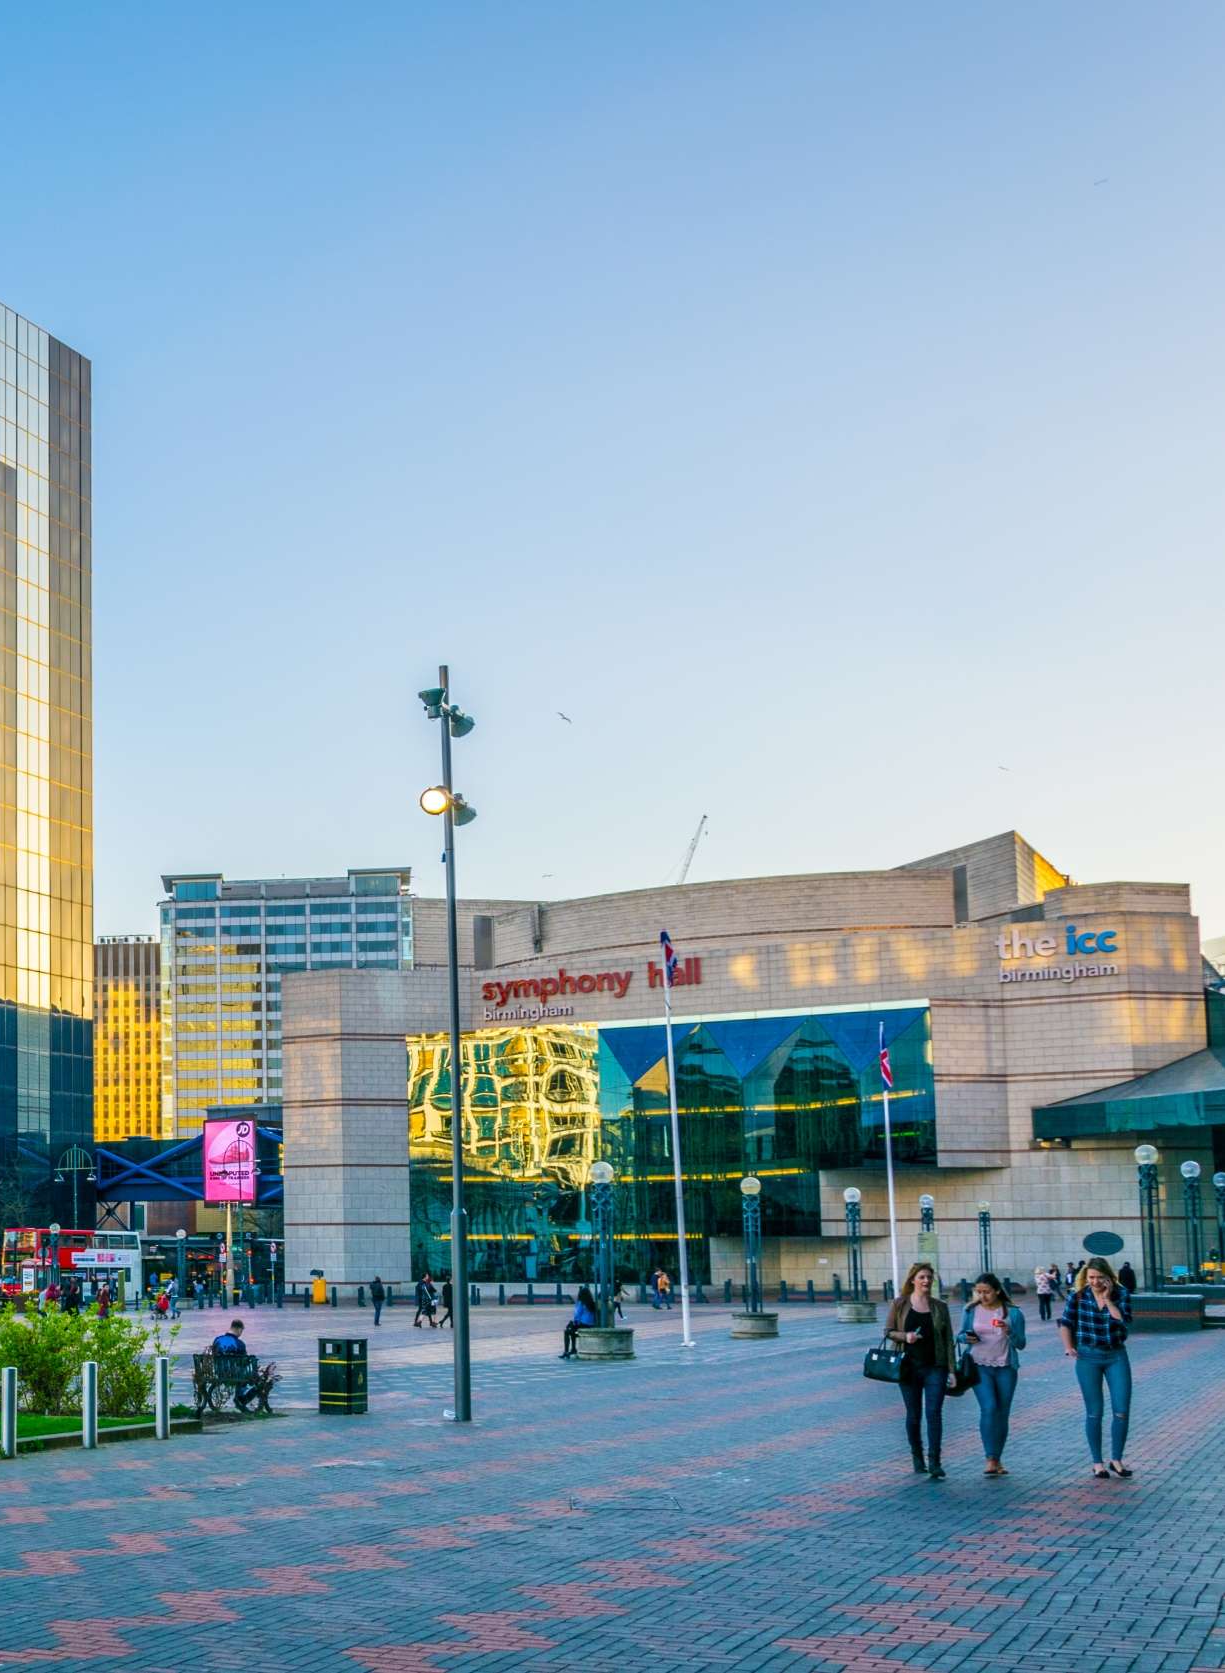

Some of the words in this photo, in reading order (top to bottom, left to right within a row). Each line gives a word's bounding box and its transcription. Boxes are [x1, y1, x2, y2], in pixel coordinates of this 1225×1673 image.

[994, 928, 1057, 960] the
[1065, 924, 1118, 955] icc
[482, 968, 633, 1008] symphony
[647, 957, 702, 989] hall
[999, 962, 1118, 984] birmingham
[483, 1003, 574, 1022] birmingham
